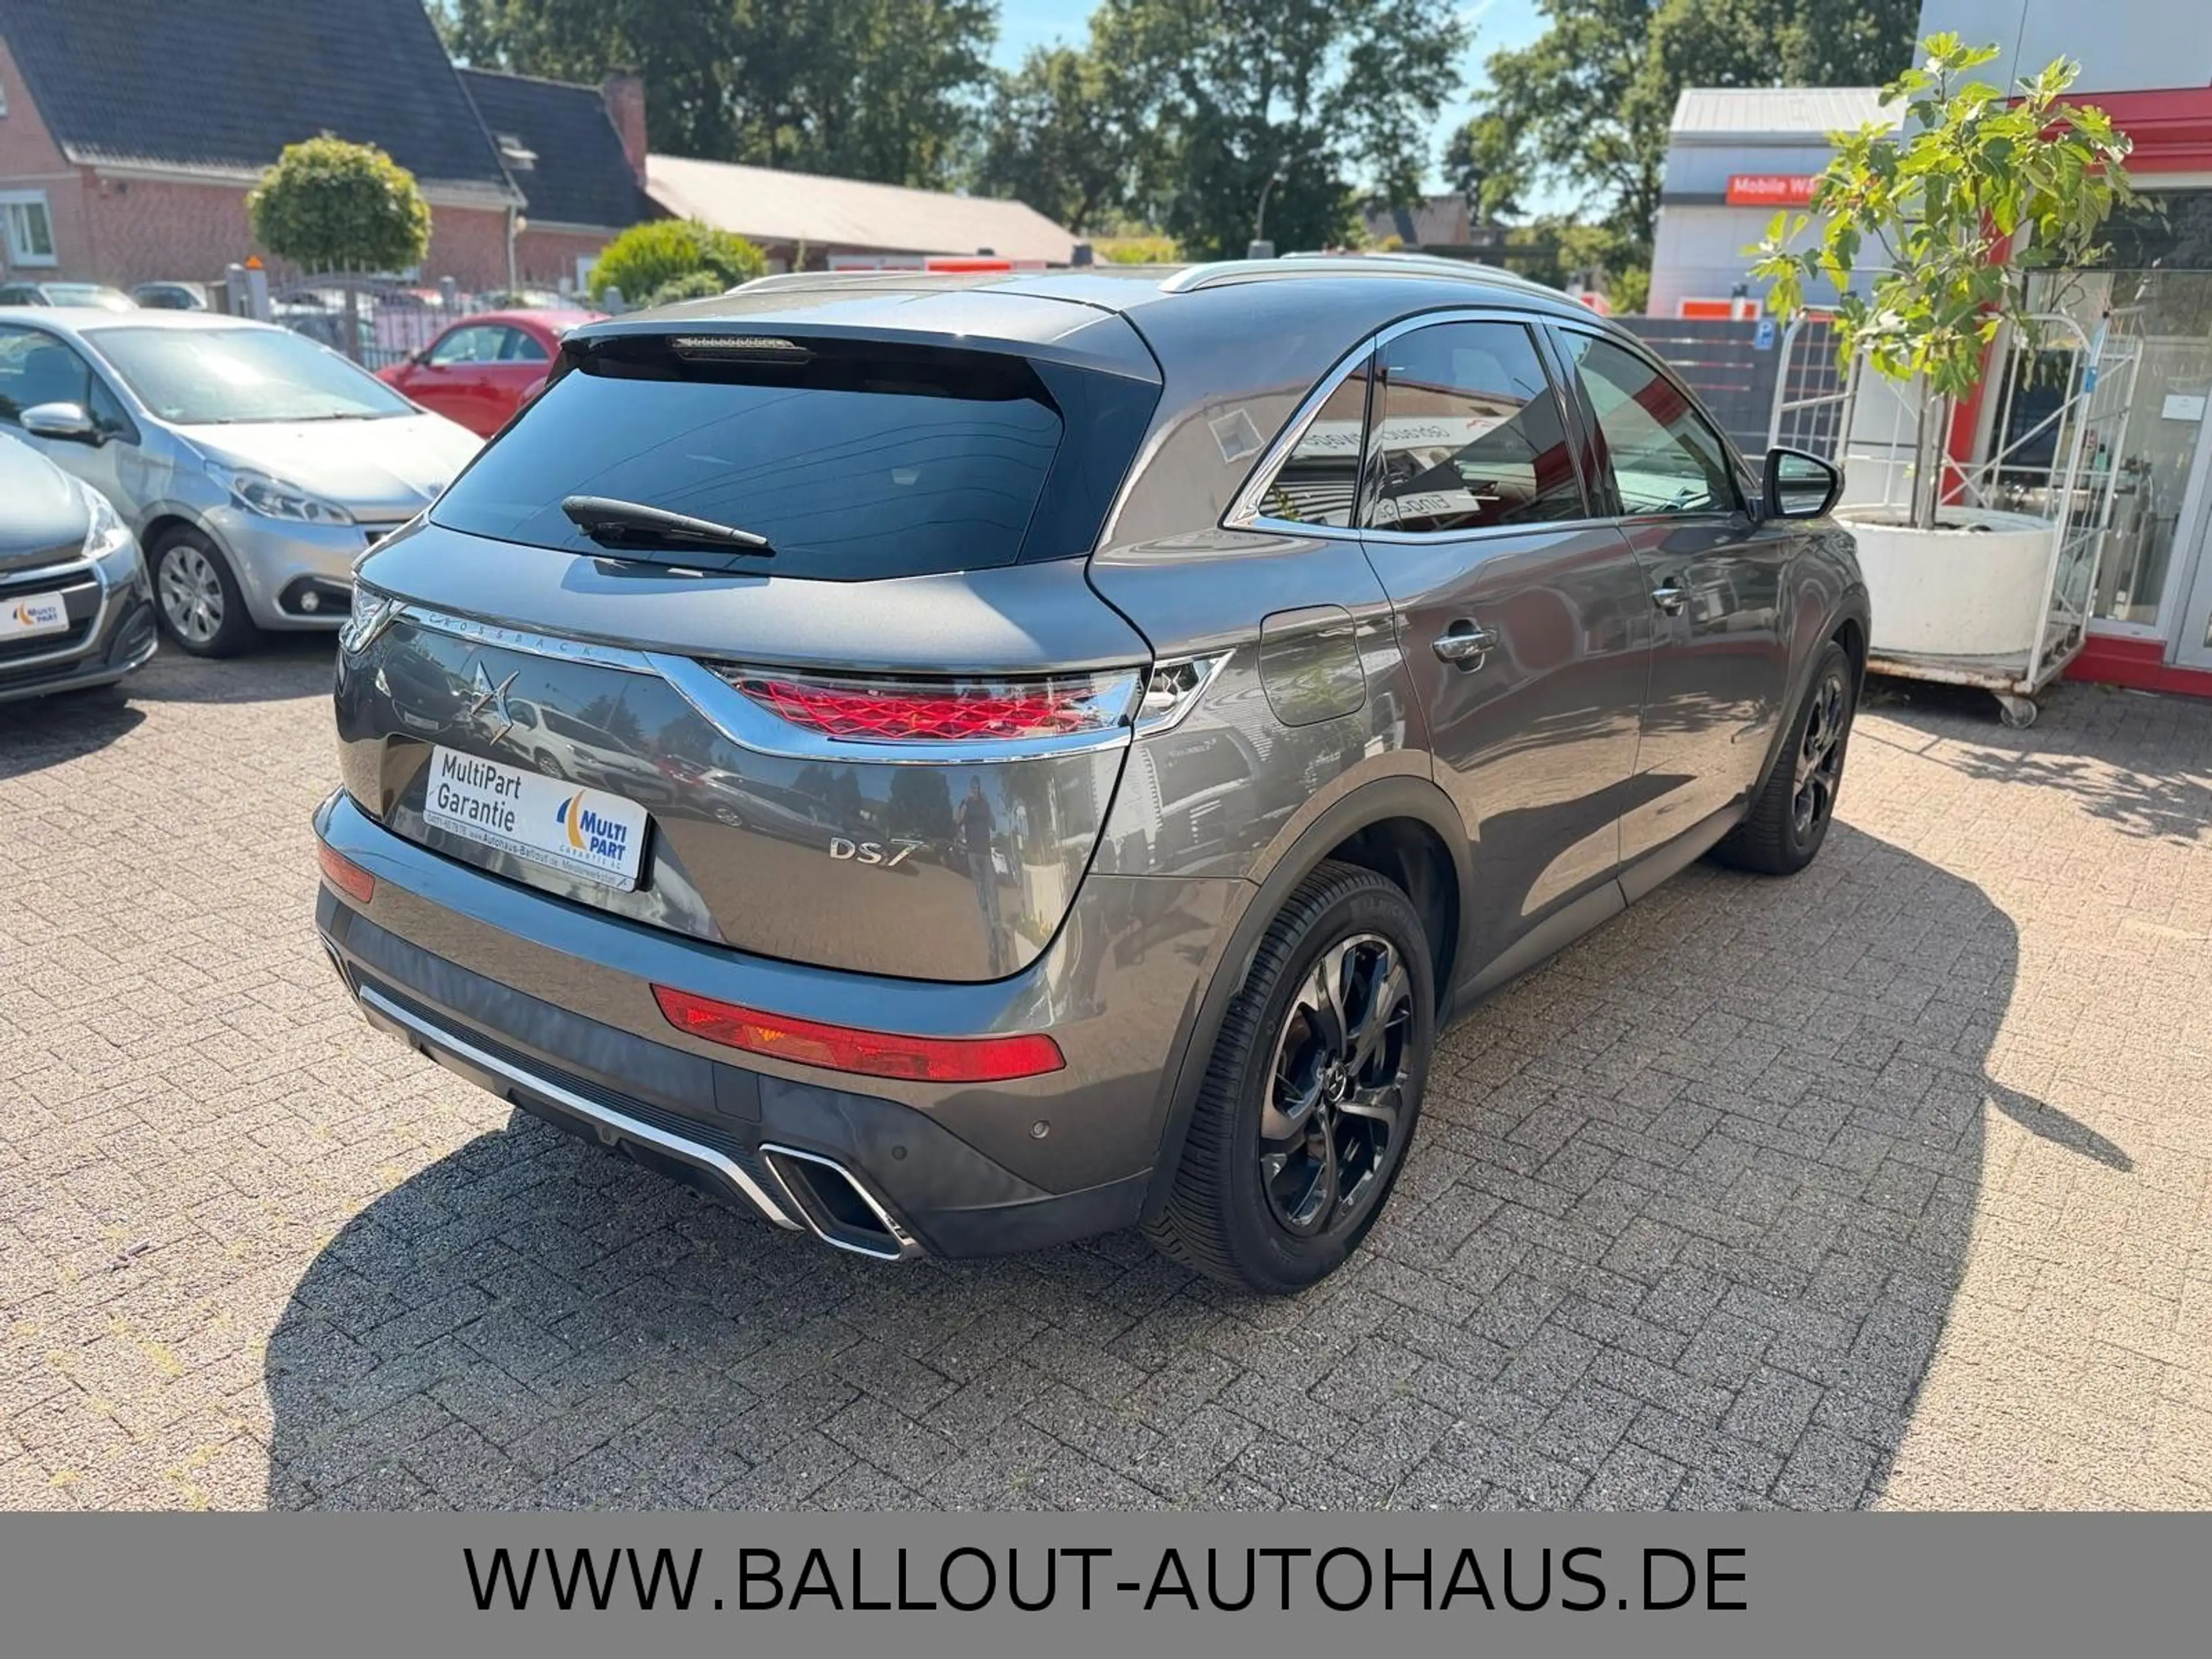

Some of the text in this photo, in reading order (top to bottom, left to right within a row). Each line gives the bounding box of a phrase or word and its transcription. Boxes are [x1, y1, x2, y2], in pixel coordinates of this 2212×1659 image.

[1733, 177, 1786, 194] Mobile
[429, 613, 591, 656] CROSSBACK
[442, 754, 522, 799] MultiPart
[438, 783, 516, 832] Garantie
[580, 810, 627, 842] MULTI
[590, 836, 626, 861] PART
